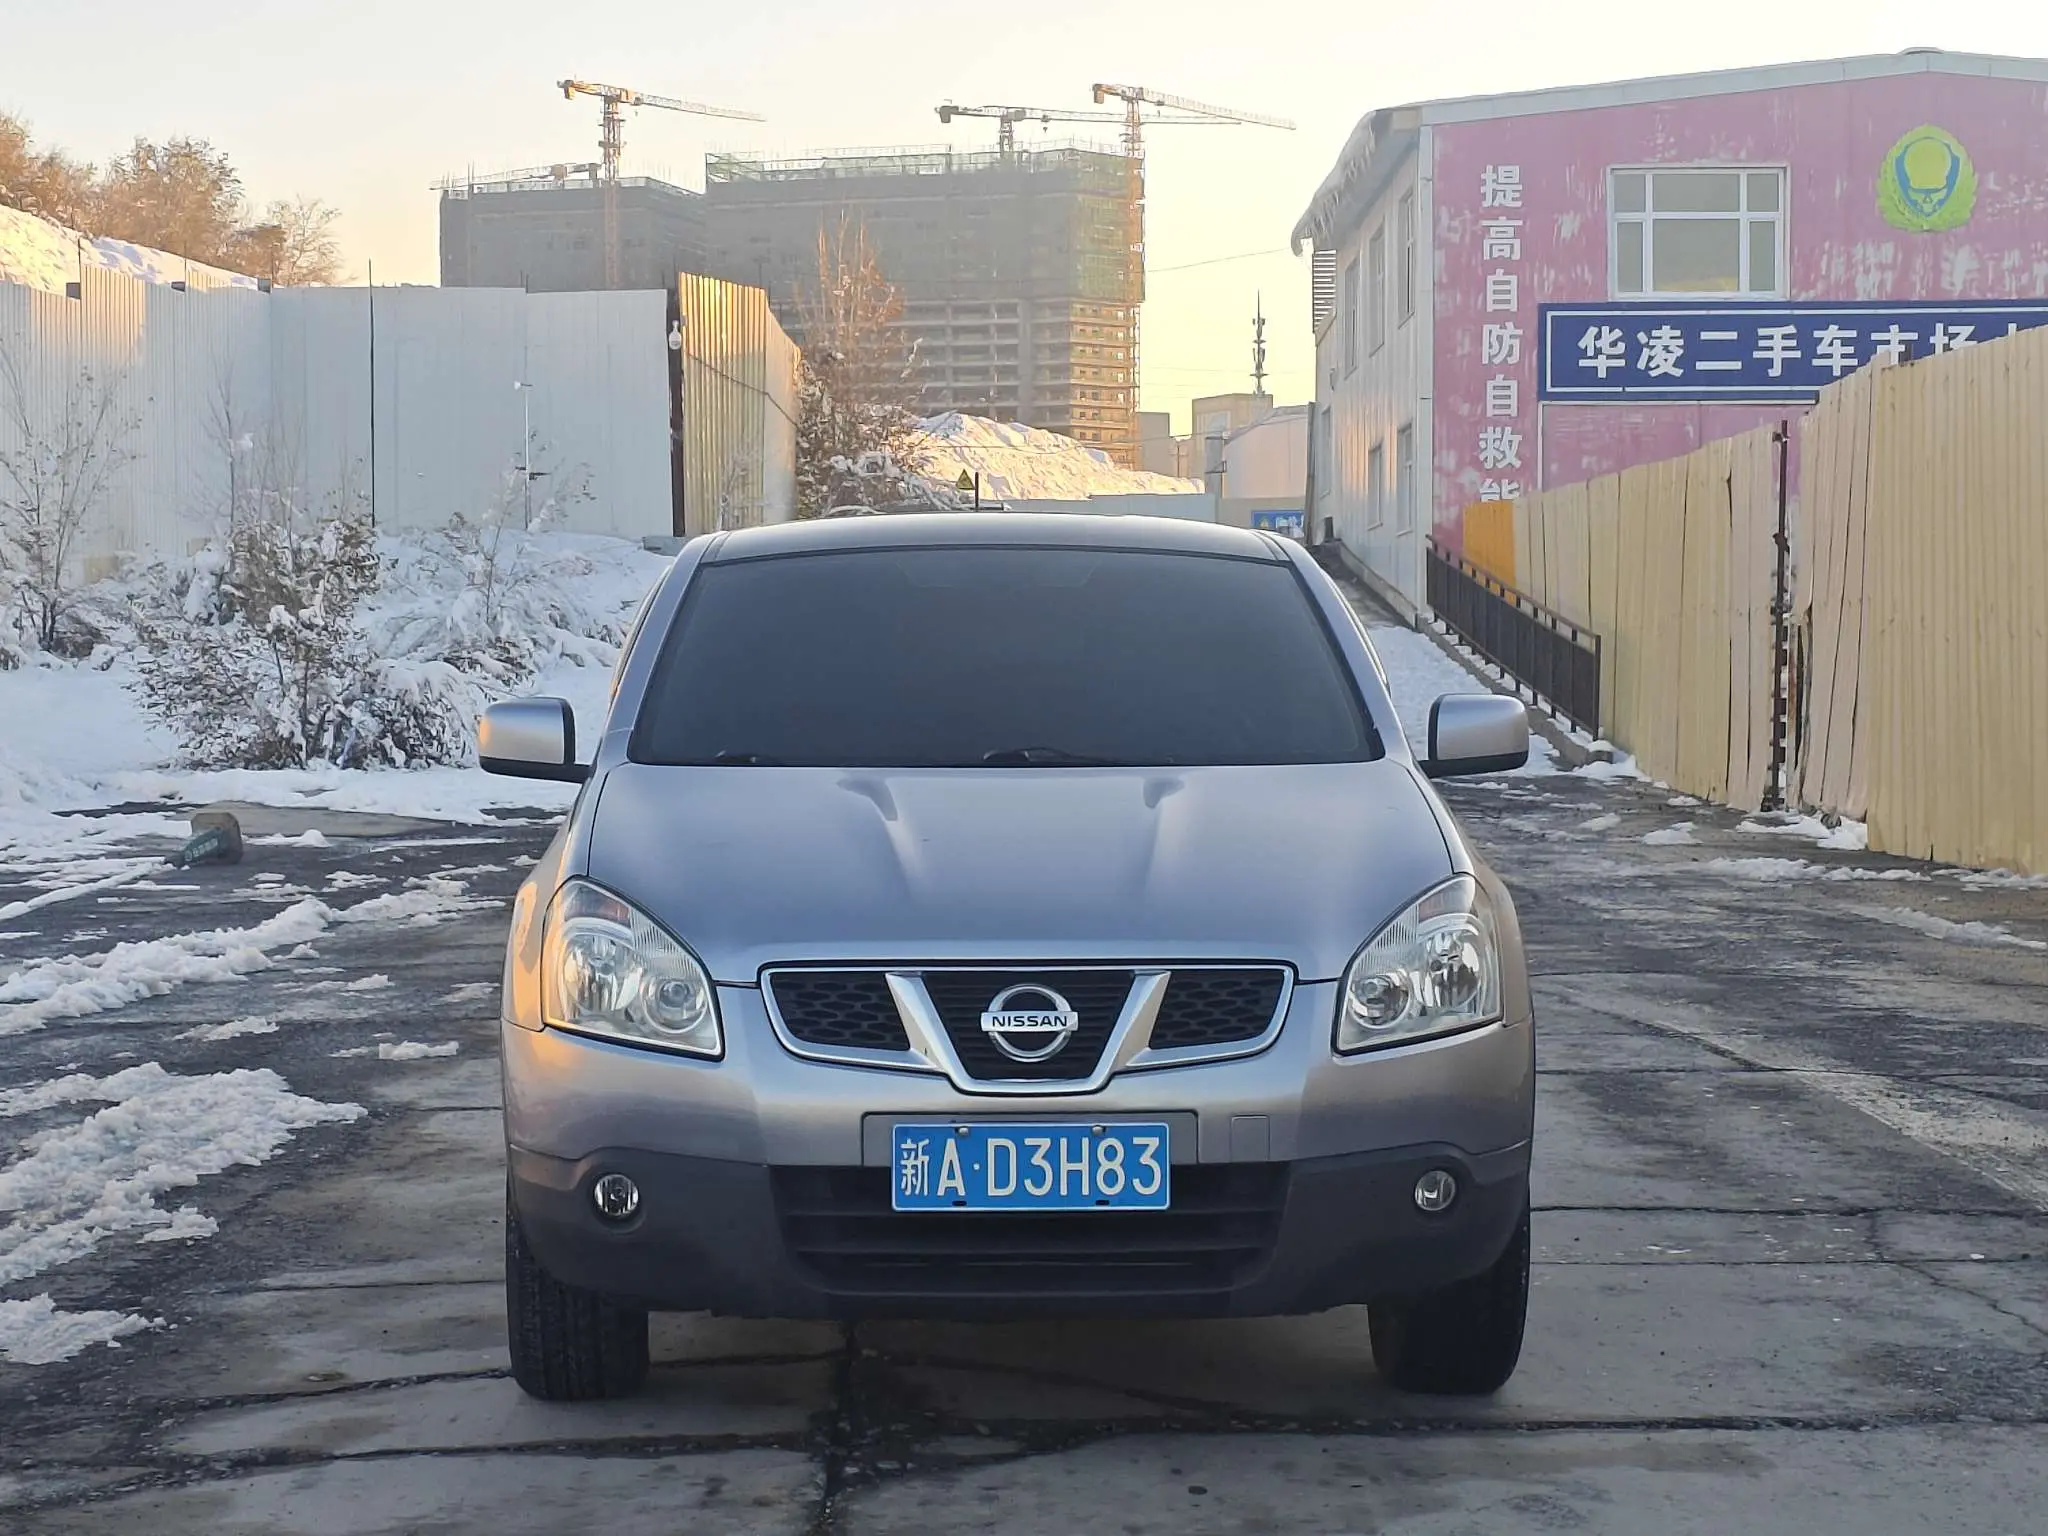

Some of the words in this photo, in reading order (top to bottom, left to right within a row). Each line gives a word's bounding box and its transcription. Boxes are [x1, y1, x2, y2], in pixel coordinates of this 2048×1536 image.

[1577, 323, 2017, 378] 华凌二手车市场
[993, 1015, 1067, 1027] NISSAN
